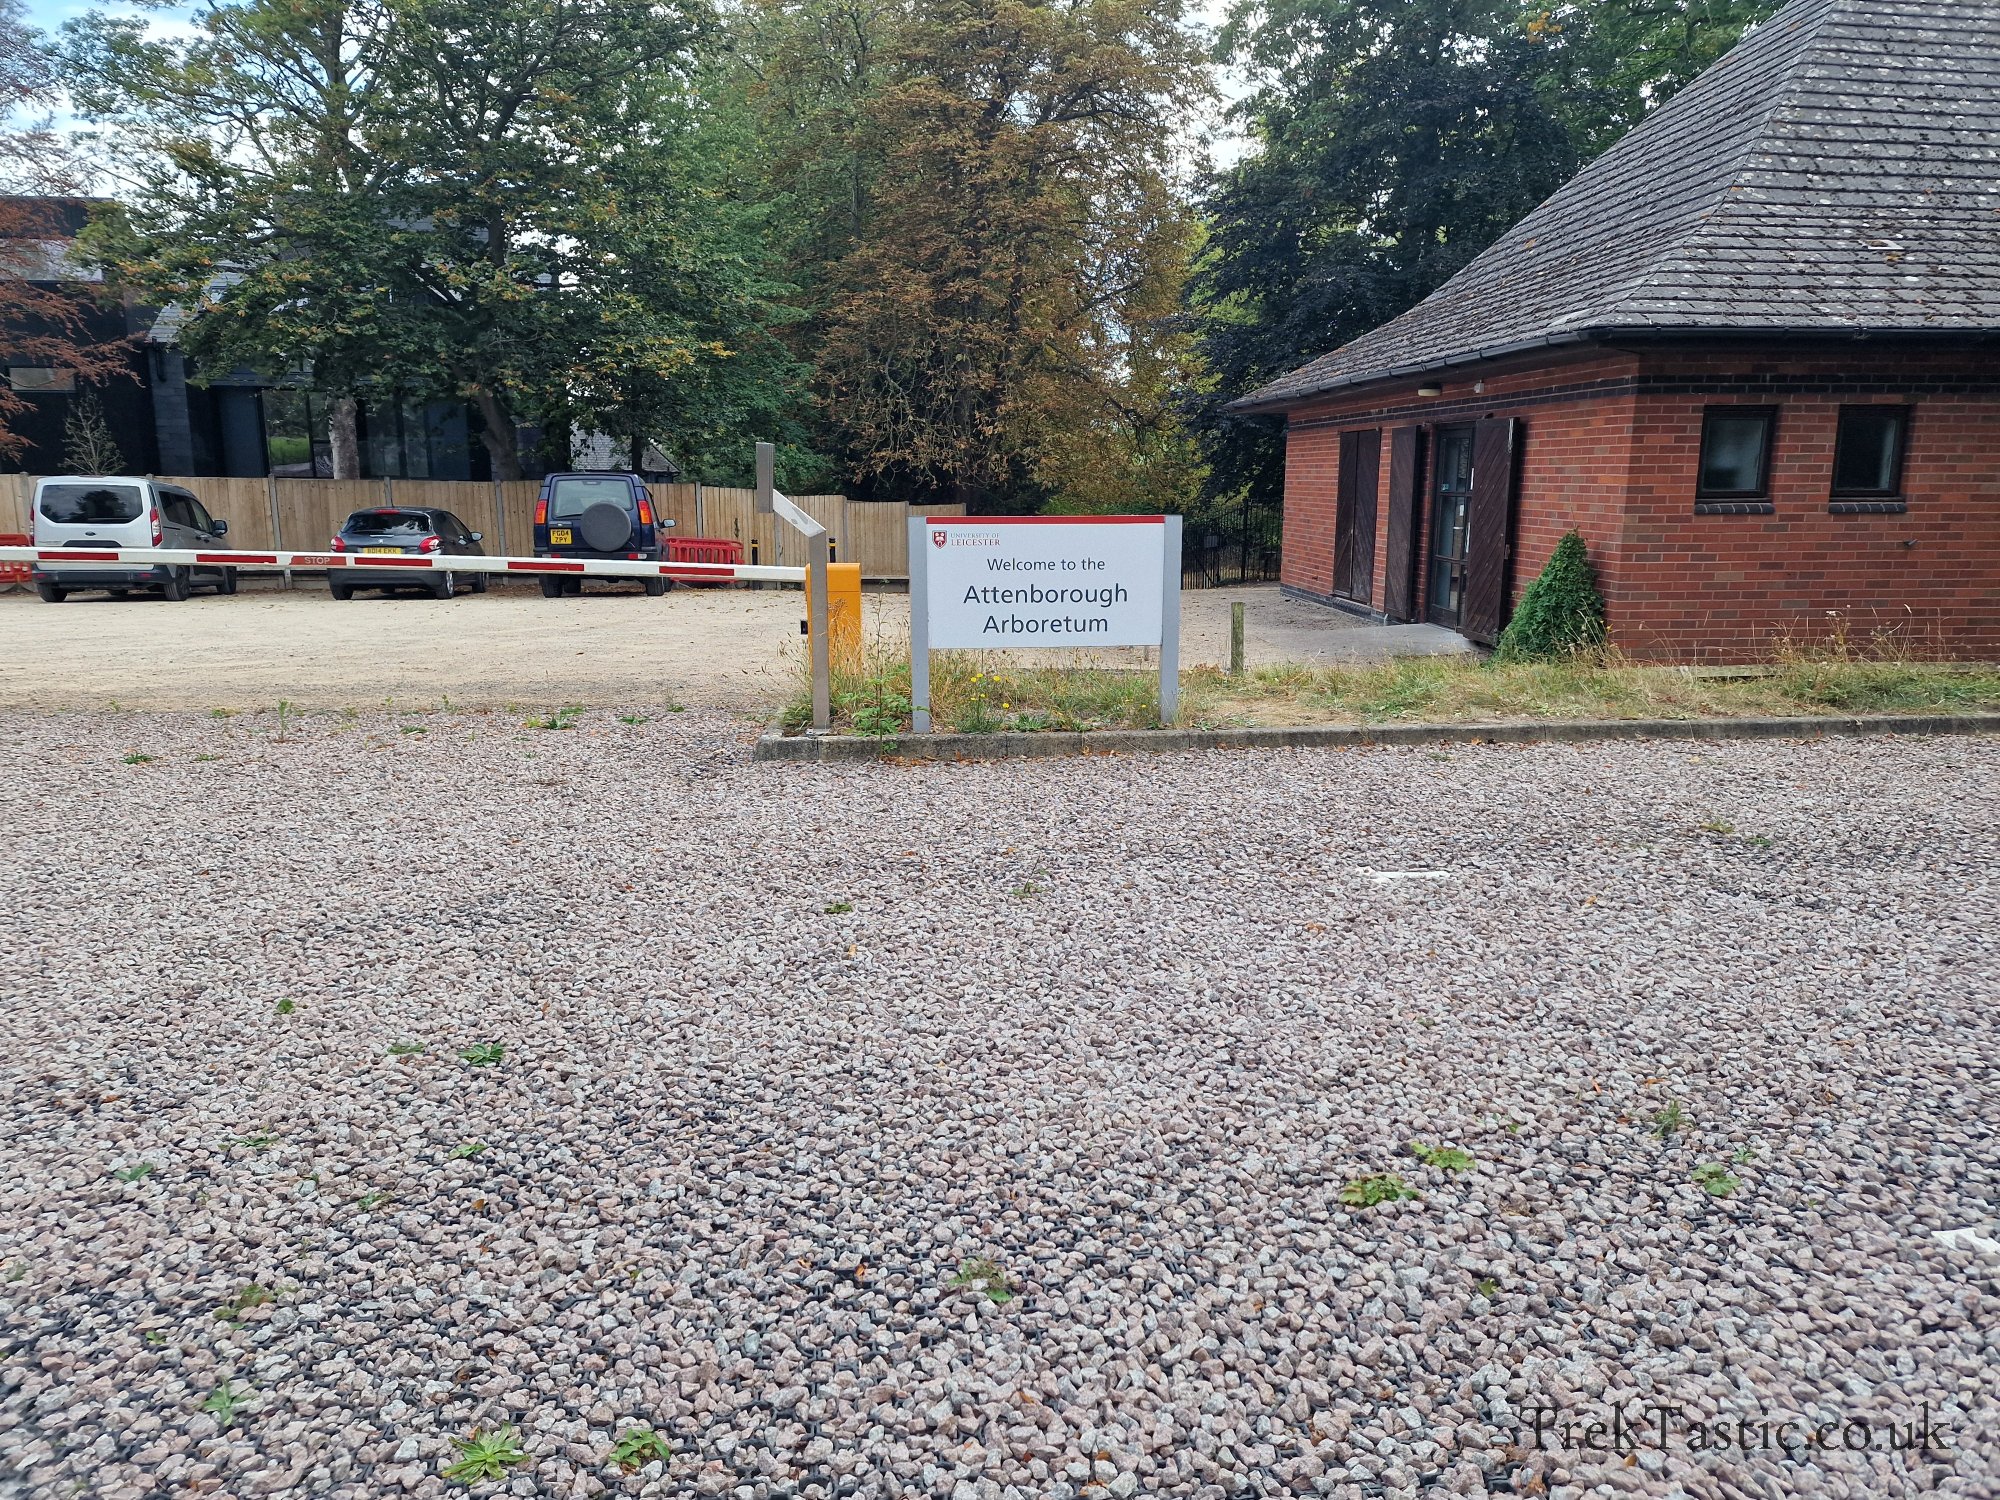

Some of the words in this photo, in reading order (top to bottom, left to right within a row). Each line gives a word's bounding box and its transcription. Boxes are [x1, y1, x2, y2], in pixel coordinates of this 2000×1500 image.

[304, 556, 331, 565] STOP
[987, 557, 1056, 571] Welcome
[1060, 558, 1077, 571] to
[1081, 557, 1106, 571] the
[963, 583, 1128, 608] Attenborough
[982, 613, 1109, 634] Arboretum
